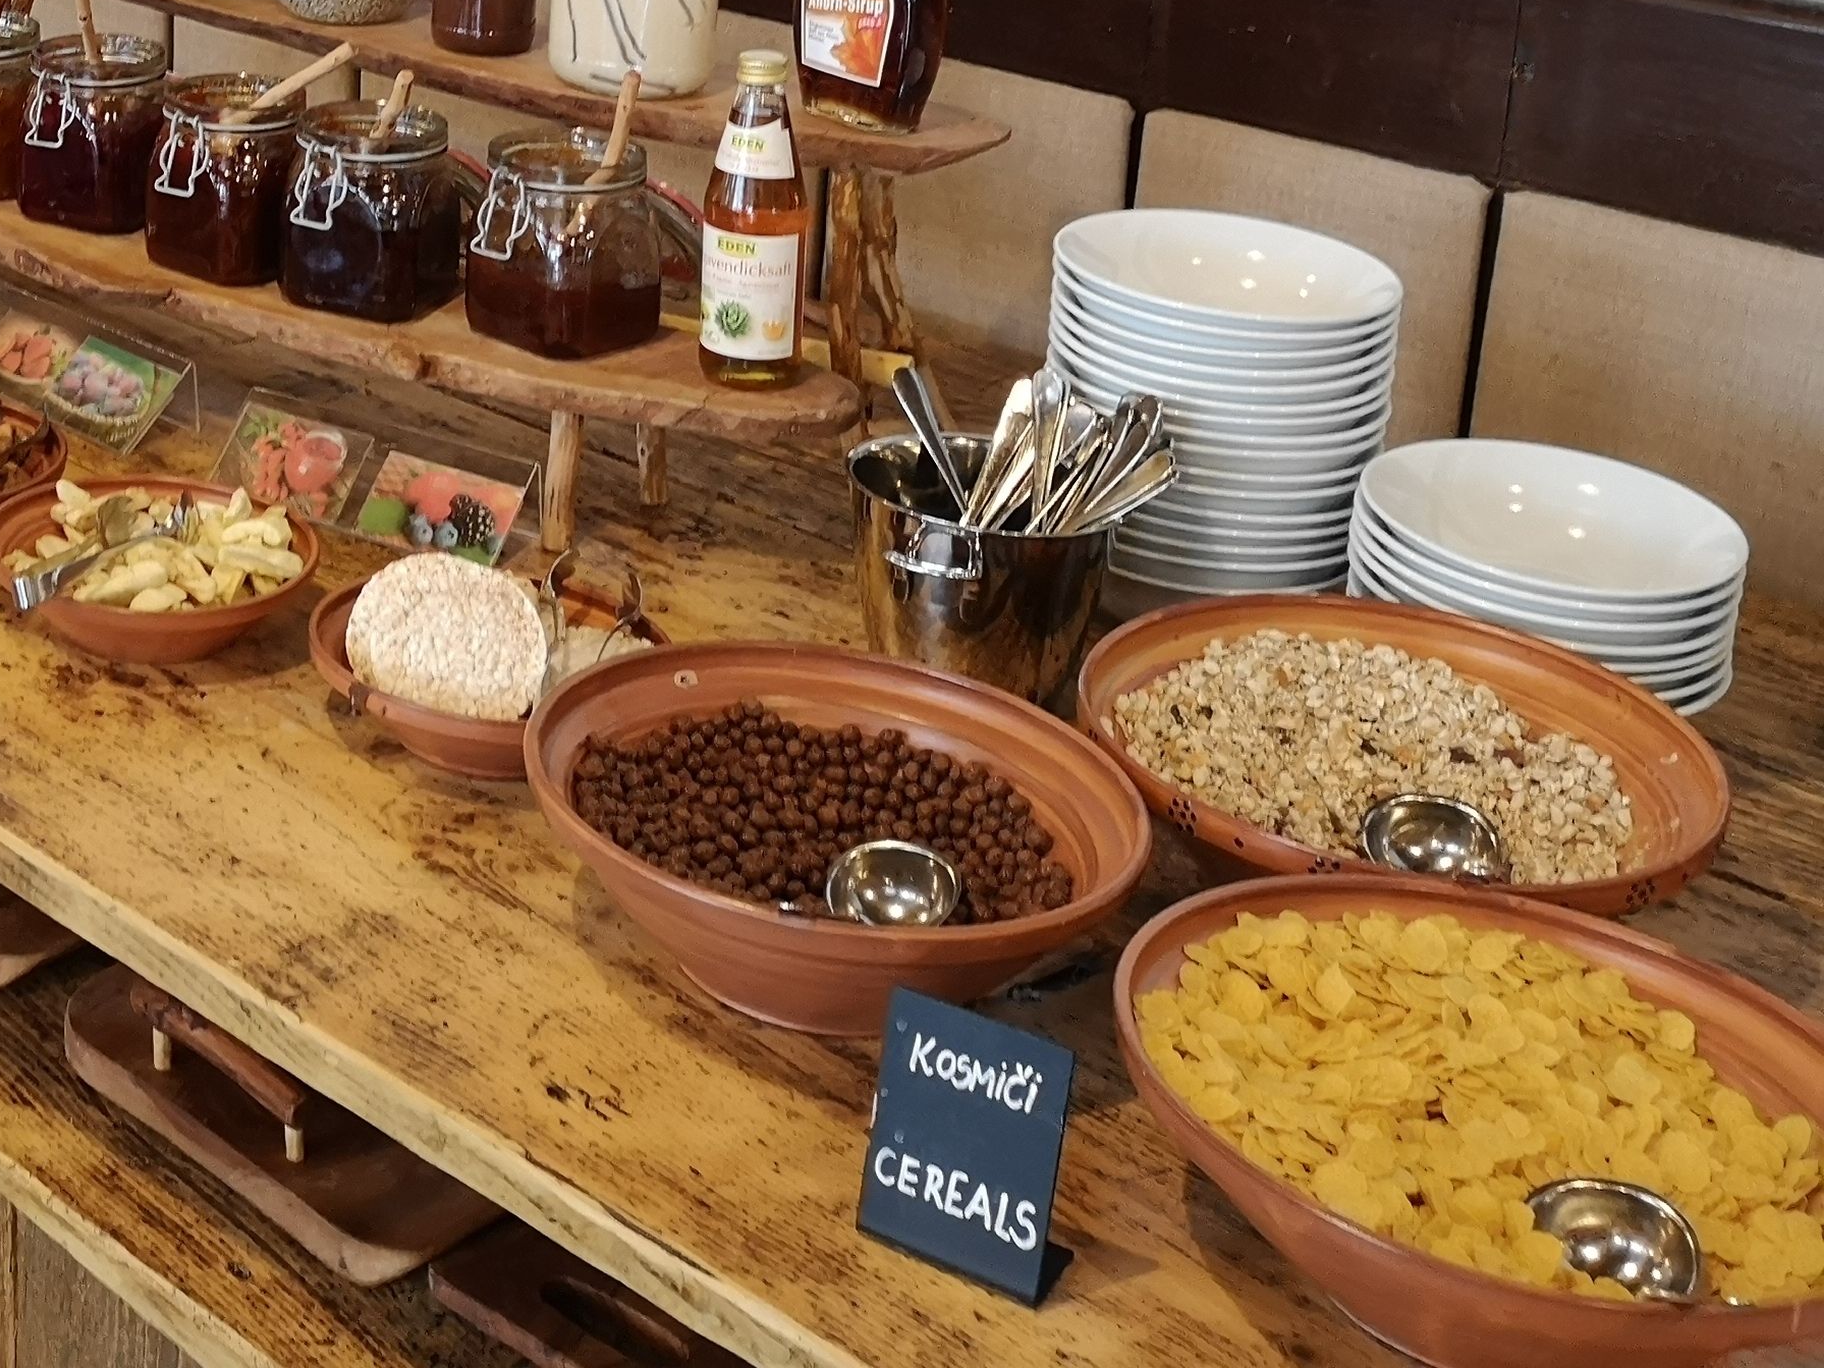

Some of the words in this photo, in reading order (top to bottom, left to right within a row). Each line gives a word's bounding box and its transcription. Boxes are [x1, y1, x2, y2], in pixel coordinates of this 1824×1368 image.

[731, 135, 764, 151] EDEN
[718, 238, 755, 255] EDEN
[874, 1146, 1038, 1252] CEREALS
